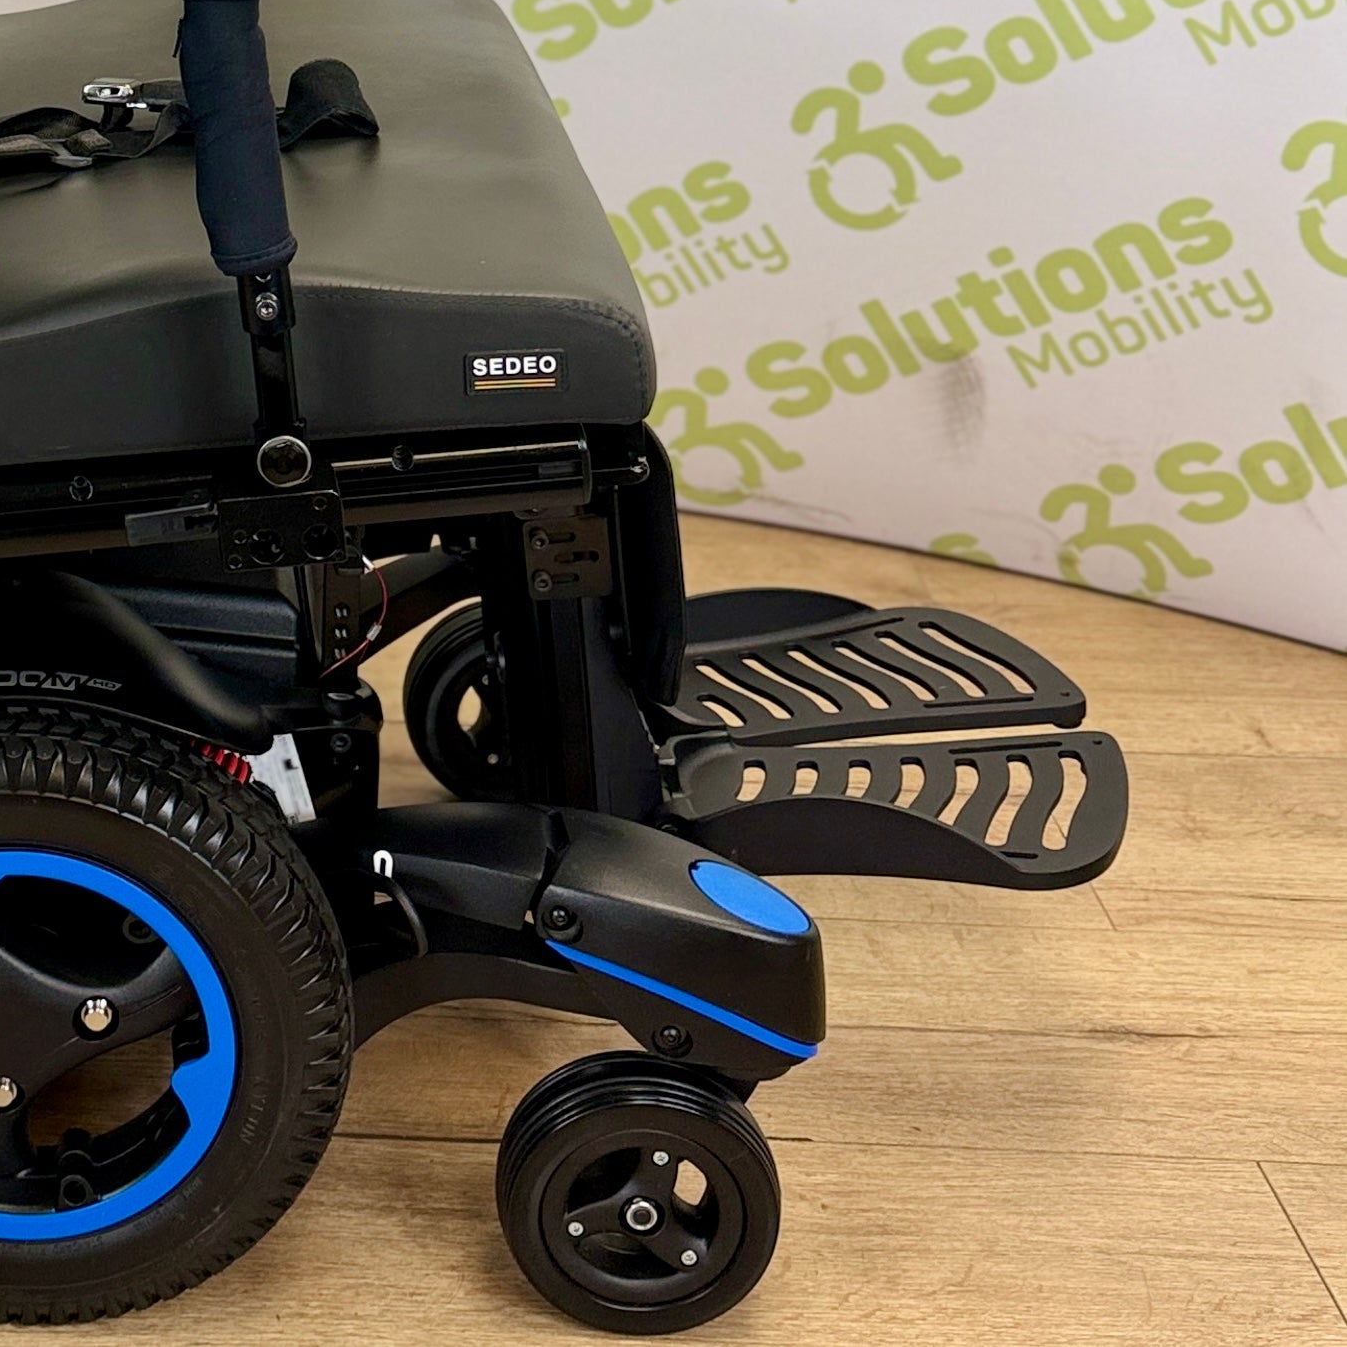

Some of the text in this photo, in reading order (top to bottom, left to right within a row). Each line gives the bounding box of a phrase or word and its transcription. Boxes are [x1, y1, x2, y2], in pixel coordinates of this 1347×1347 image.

[634, 223, 791, 309] bility
[745, 197, 1234, 420] Solutions
[472, 355, 557, 377] SEDEO
[1007, 267, 1274, 391] Mobility
